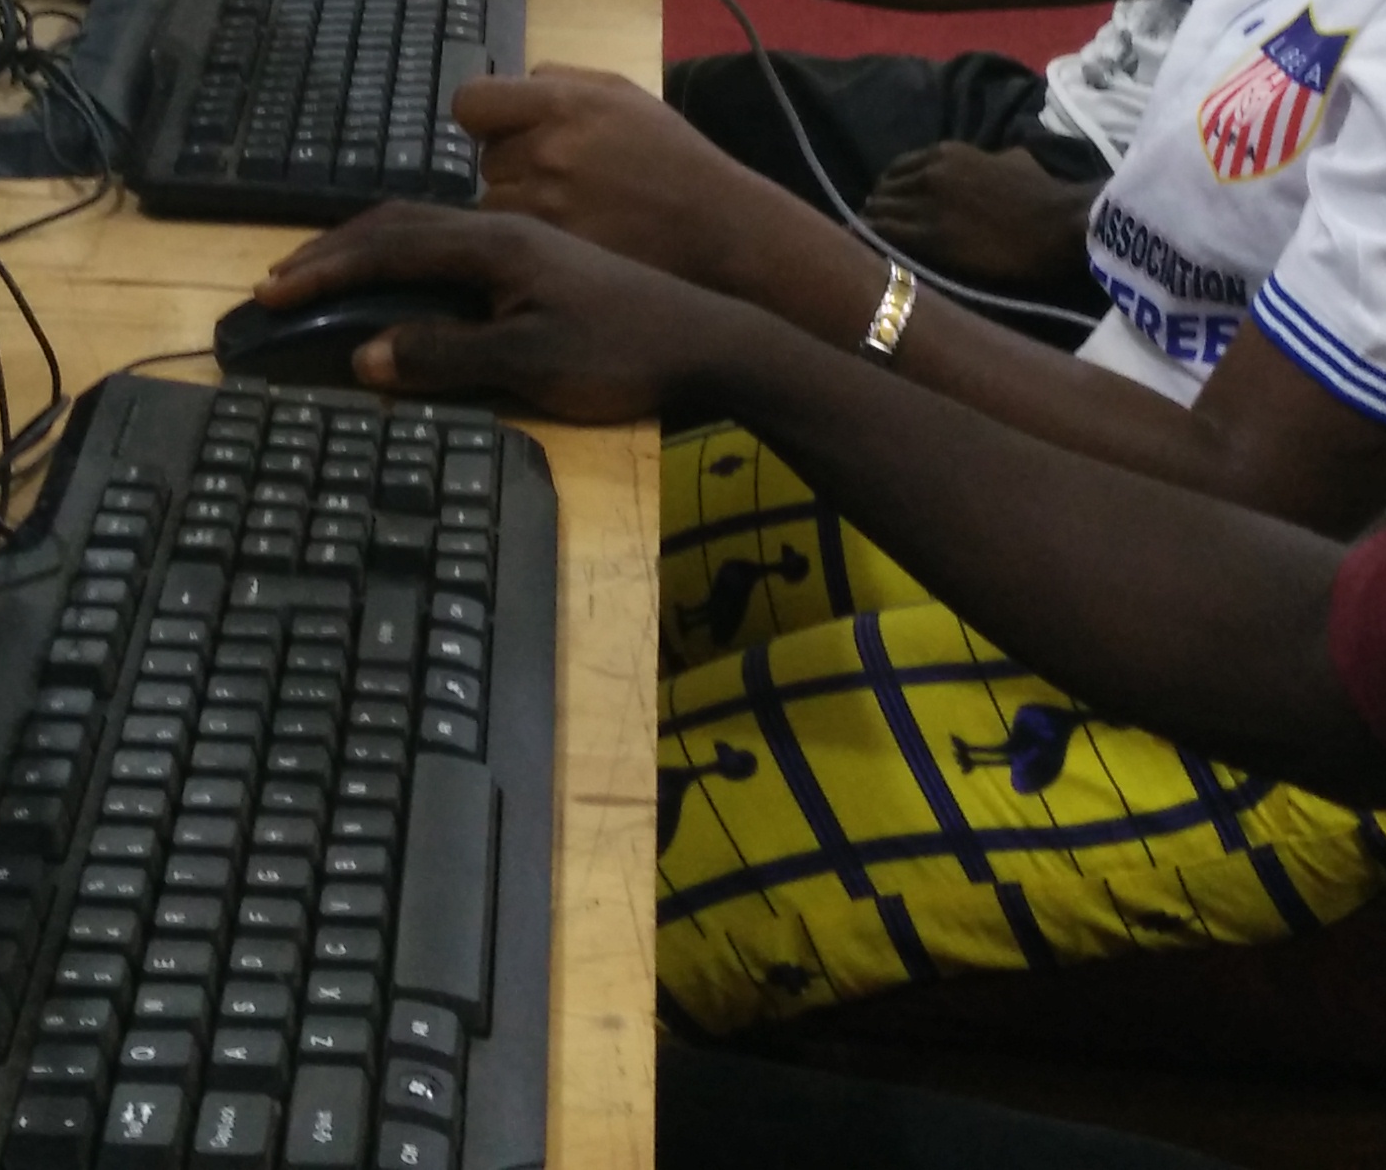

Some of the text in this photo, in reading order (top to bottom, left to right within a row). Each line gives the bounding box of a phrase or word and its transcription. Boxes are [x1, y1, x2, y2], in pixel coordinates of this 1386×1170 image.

[1093, 198, 1248, 307] ASSOCIATION
[318, 987, 341, 1000] X
[309, 1035, 334, 1048] Z
[130, 1046, 156, 1061] Q
[223, 1047, 248, 1060] A
